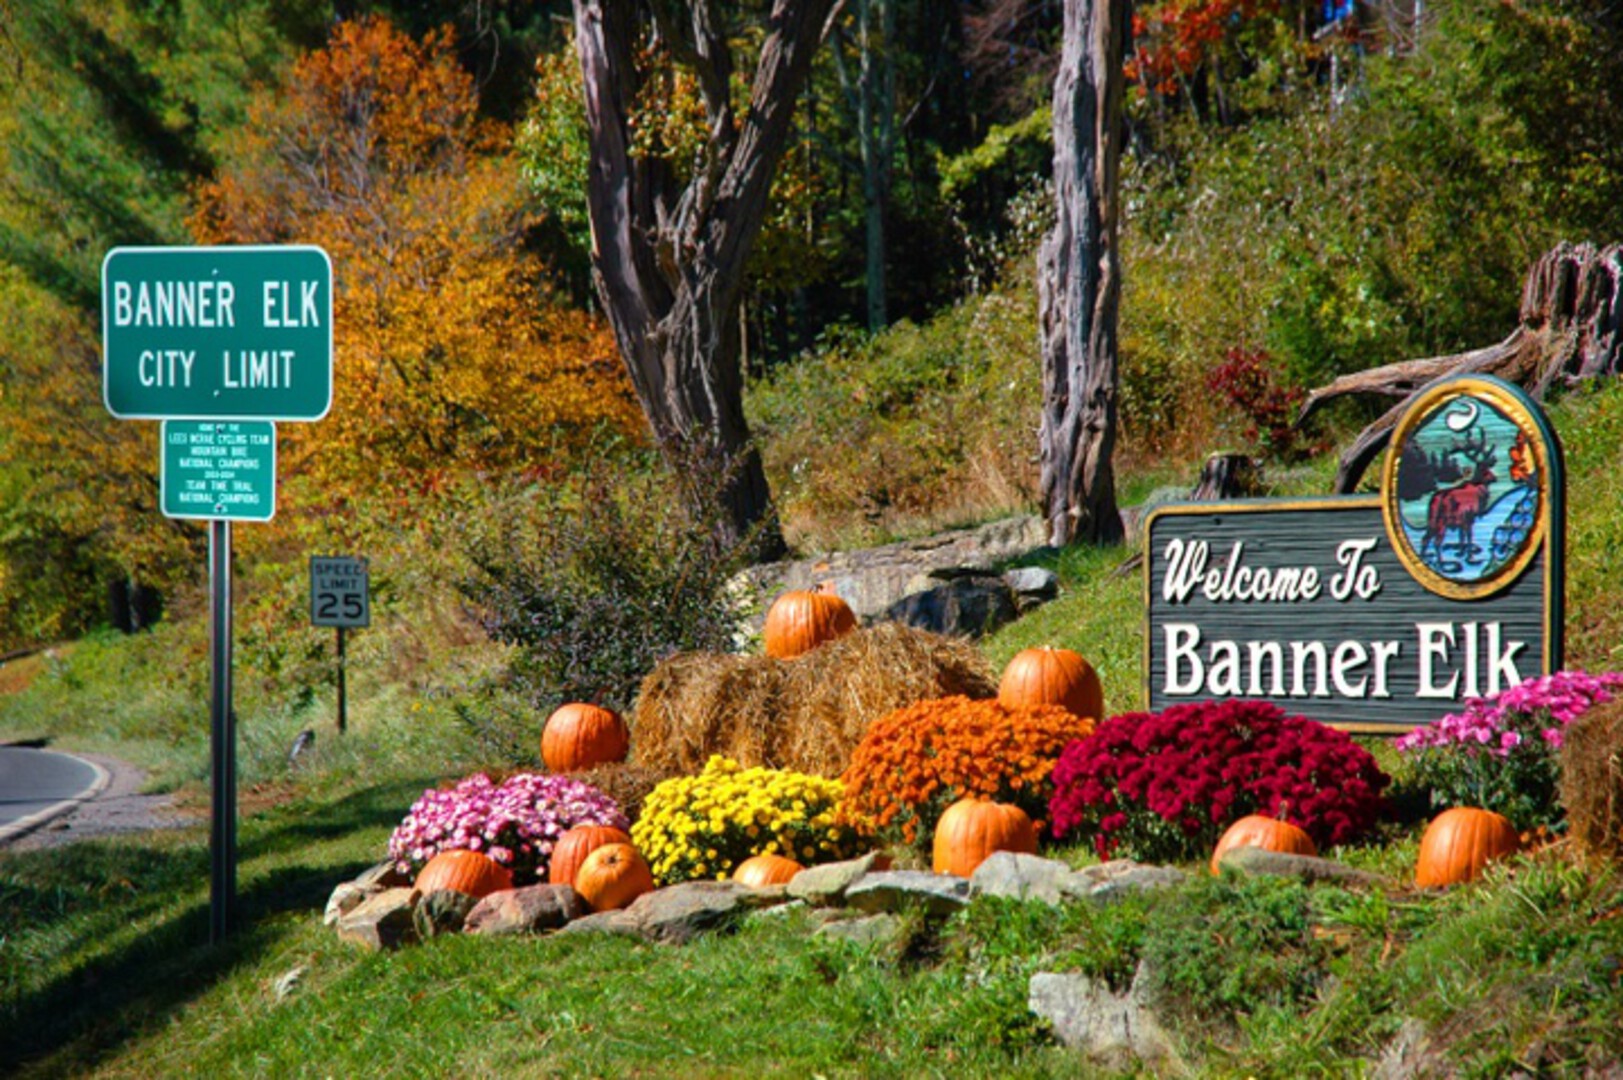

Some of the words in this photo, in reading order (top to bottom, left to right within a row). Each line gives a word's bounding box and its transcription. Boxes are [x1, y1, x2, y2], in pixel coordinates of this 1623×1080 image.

[114, 281, 235, 327] BANNER
[263, 281, 320, 327] ELK
[138, 350, 196, 387] CITY
[223, 350, 295, 388] LIMIT
[249, 434, 270, 445] TEAM
[179, 458, 214, 469] NATIONAL
[218, 458, 260, 470] CHAMPIONS
[179, 492, 214, 503] NATIONAL
[218, 493, 260, 505] CHAMPIONS
[1162, 538, 1321, 601] Welcome
[1330, 537, 1381, 600] To
[321, 579, 357, 589] LIMIT
[318, 593, 363, 618] 25
[1162, 623, 1398, 698] Banner
[1416, 621, 1527, 699] Elk
